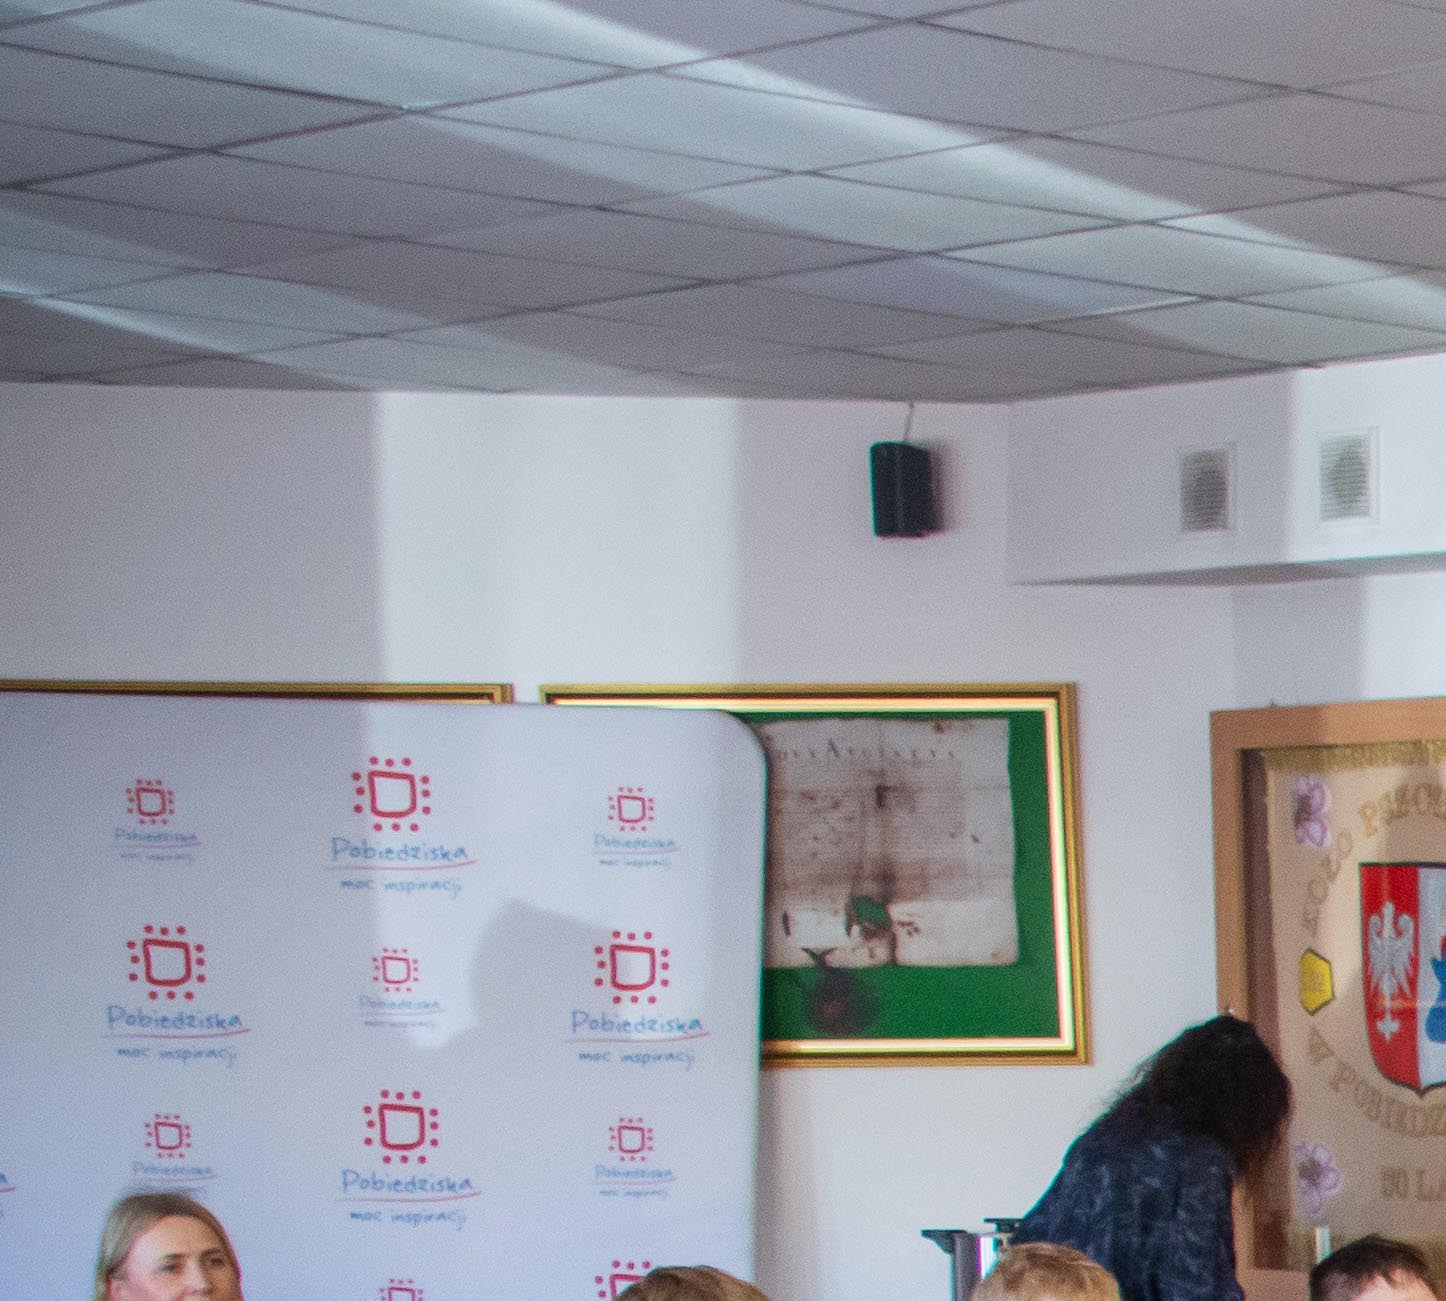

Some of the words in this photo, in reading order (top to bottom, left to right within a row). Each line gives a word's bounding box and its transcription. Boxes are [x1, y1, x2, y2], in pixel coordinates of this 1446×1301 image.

[331, 836, 470, 861] Pobiedziska
[340, 878, 374, 891] moc
[383, 876, 462, 900] inspiracji
[106, 1004, 243, 1029] Pobiedziska
[571, 1009, 703, 1033] Pobiedziska
[117, 1046, 151, 1059] moc
[158, 1044, 238, 1068] inspiracji
[578, 1050, 611, 1063] moc
[619, 1048, 695, 1072] inspiracji
[341, 1169, 473, 1194] Pobiedziska
[349, 1209, 382, 1222] moc
[390, 1208, 467, 1232] inspiracji
